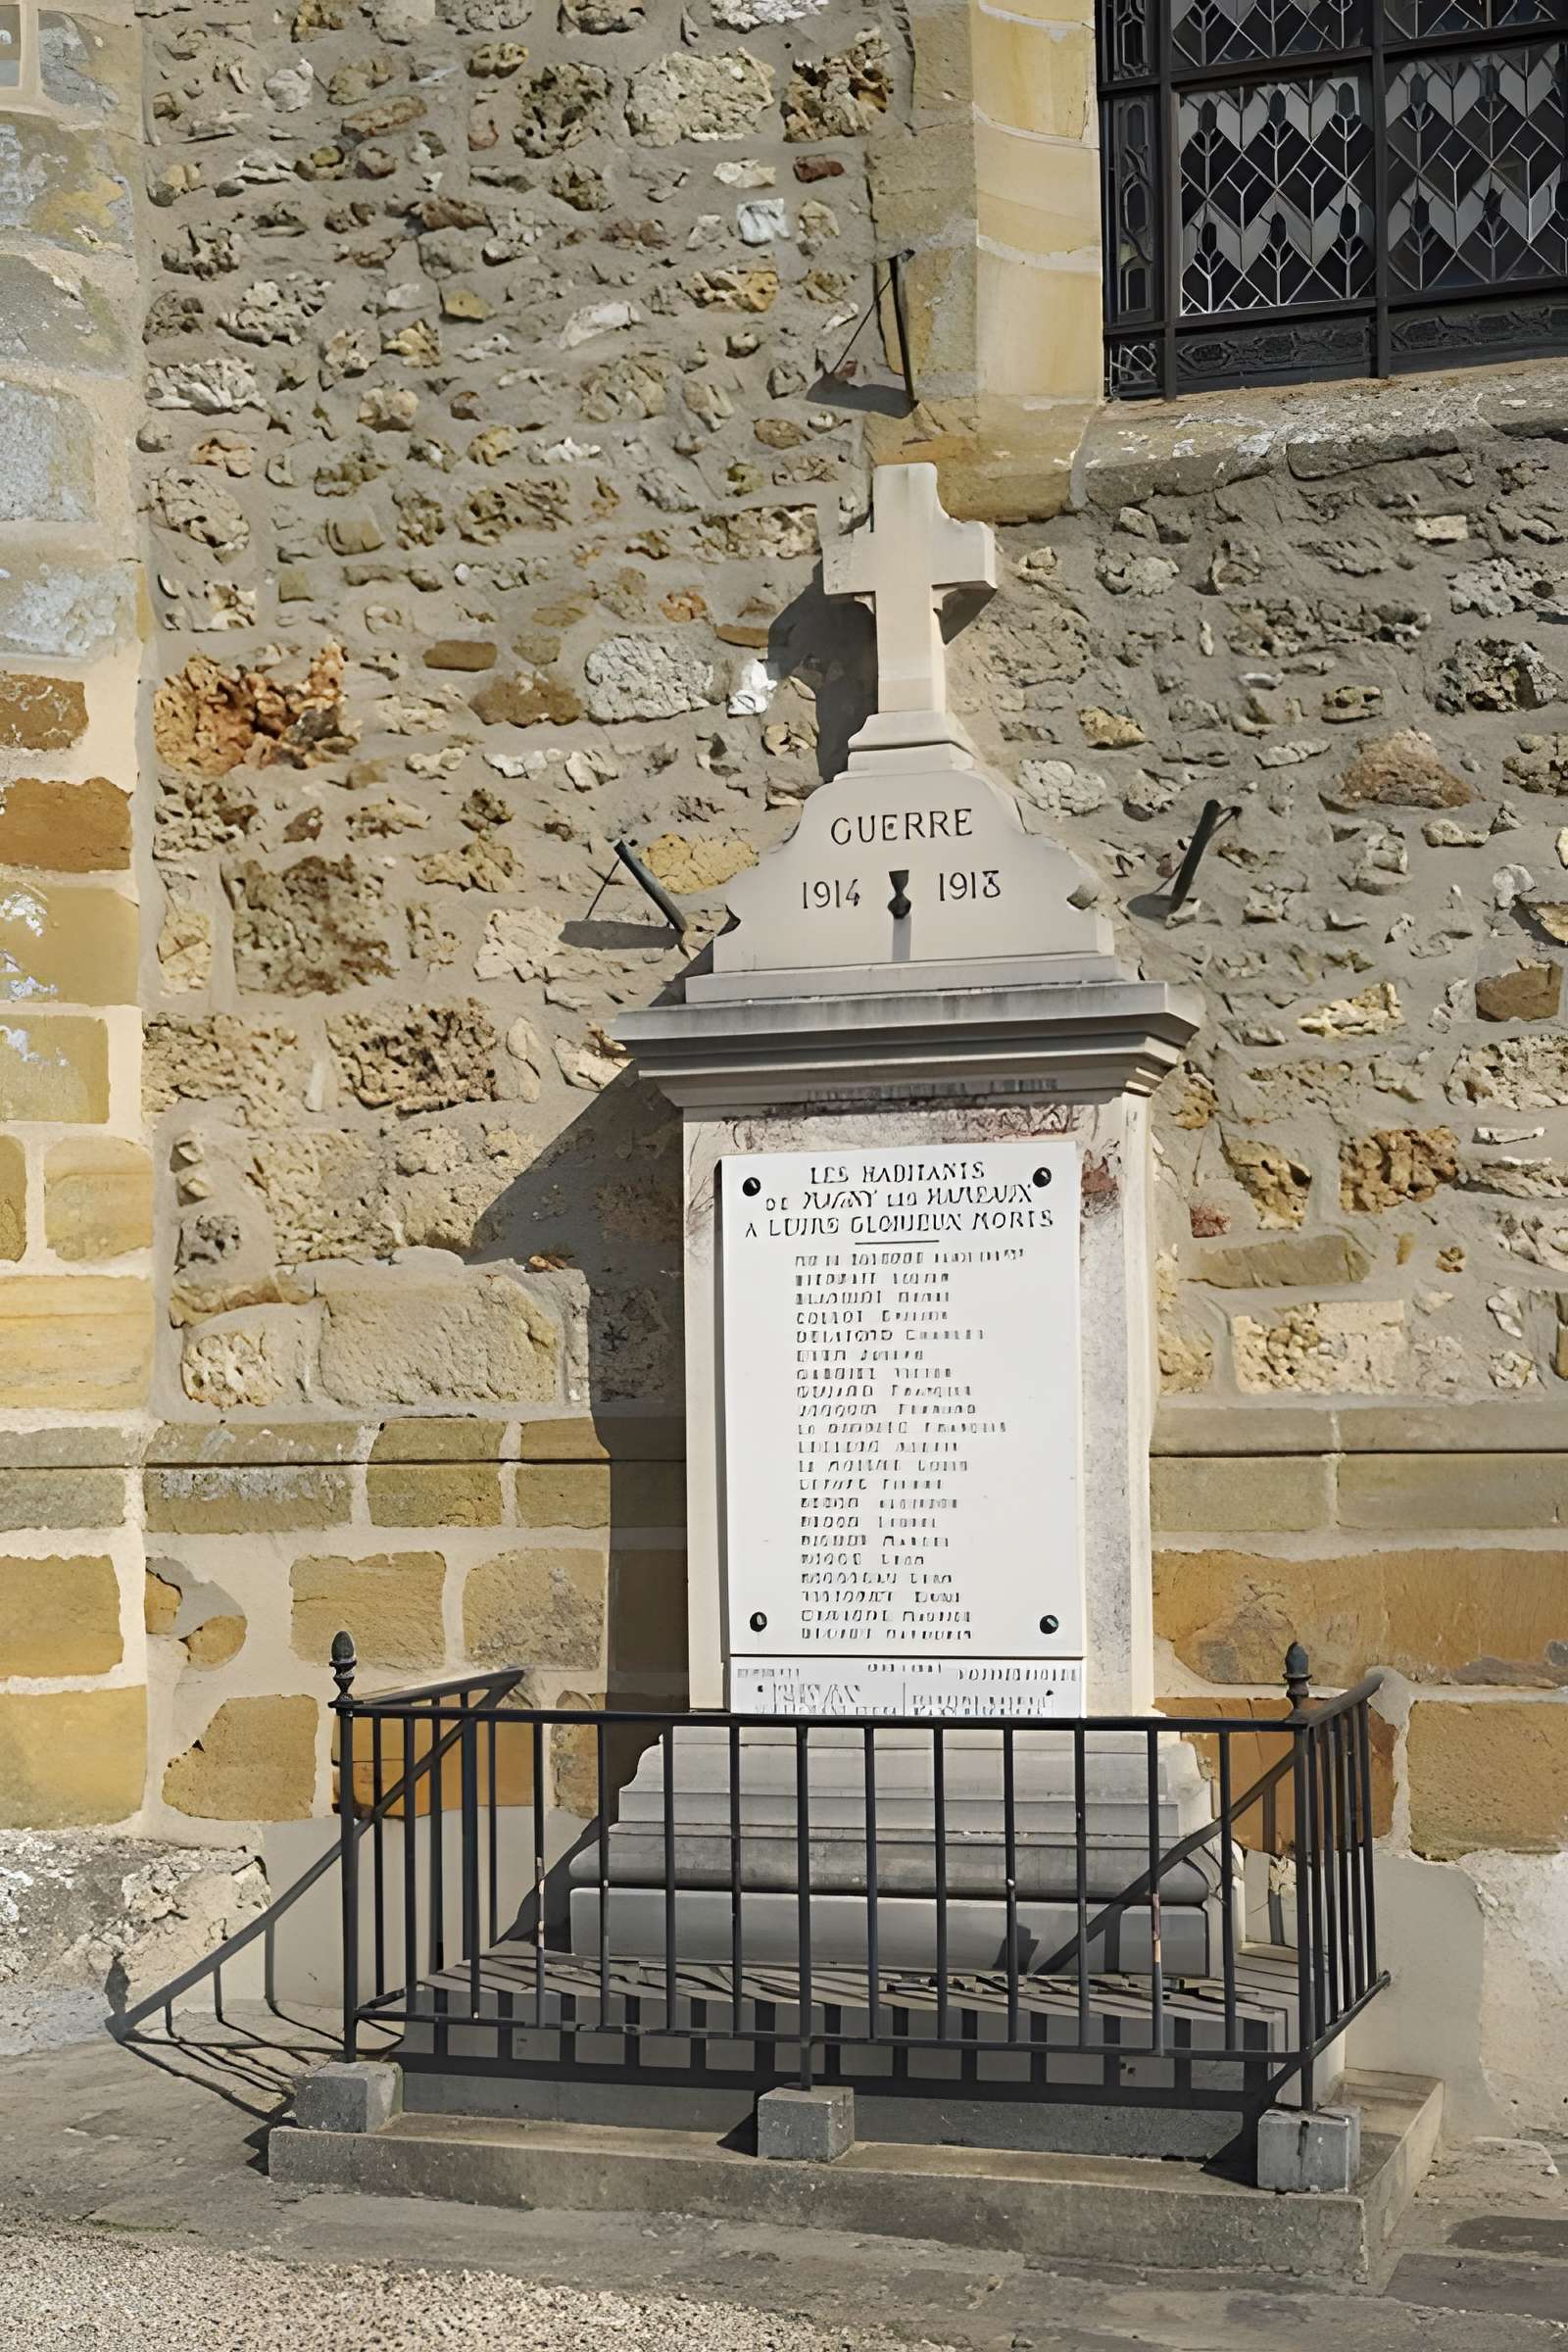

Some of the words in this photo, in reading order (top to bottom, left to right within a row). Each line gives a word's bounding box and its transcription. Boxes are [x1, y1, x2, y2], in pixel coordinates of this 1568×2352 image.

[831, 808, 972, 845] GUERRE
[804, 879, 859, 908] 1914
[940, 870, 1001, 901] 1918
